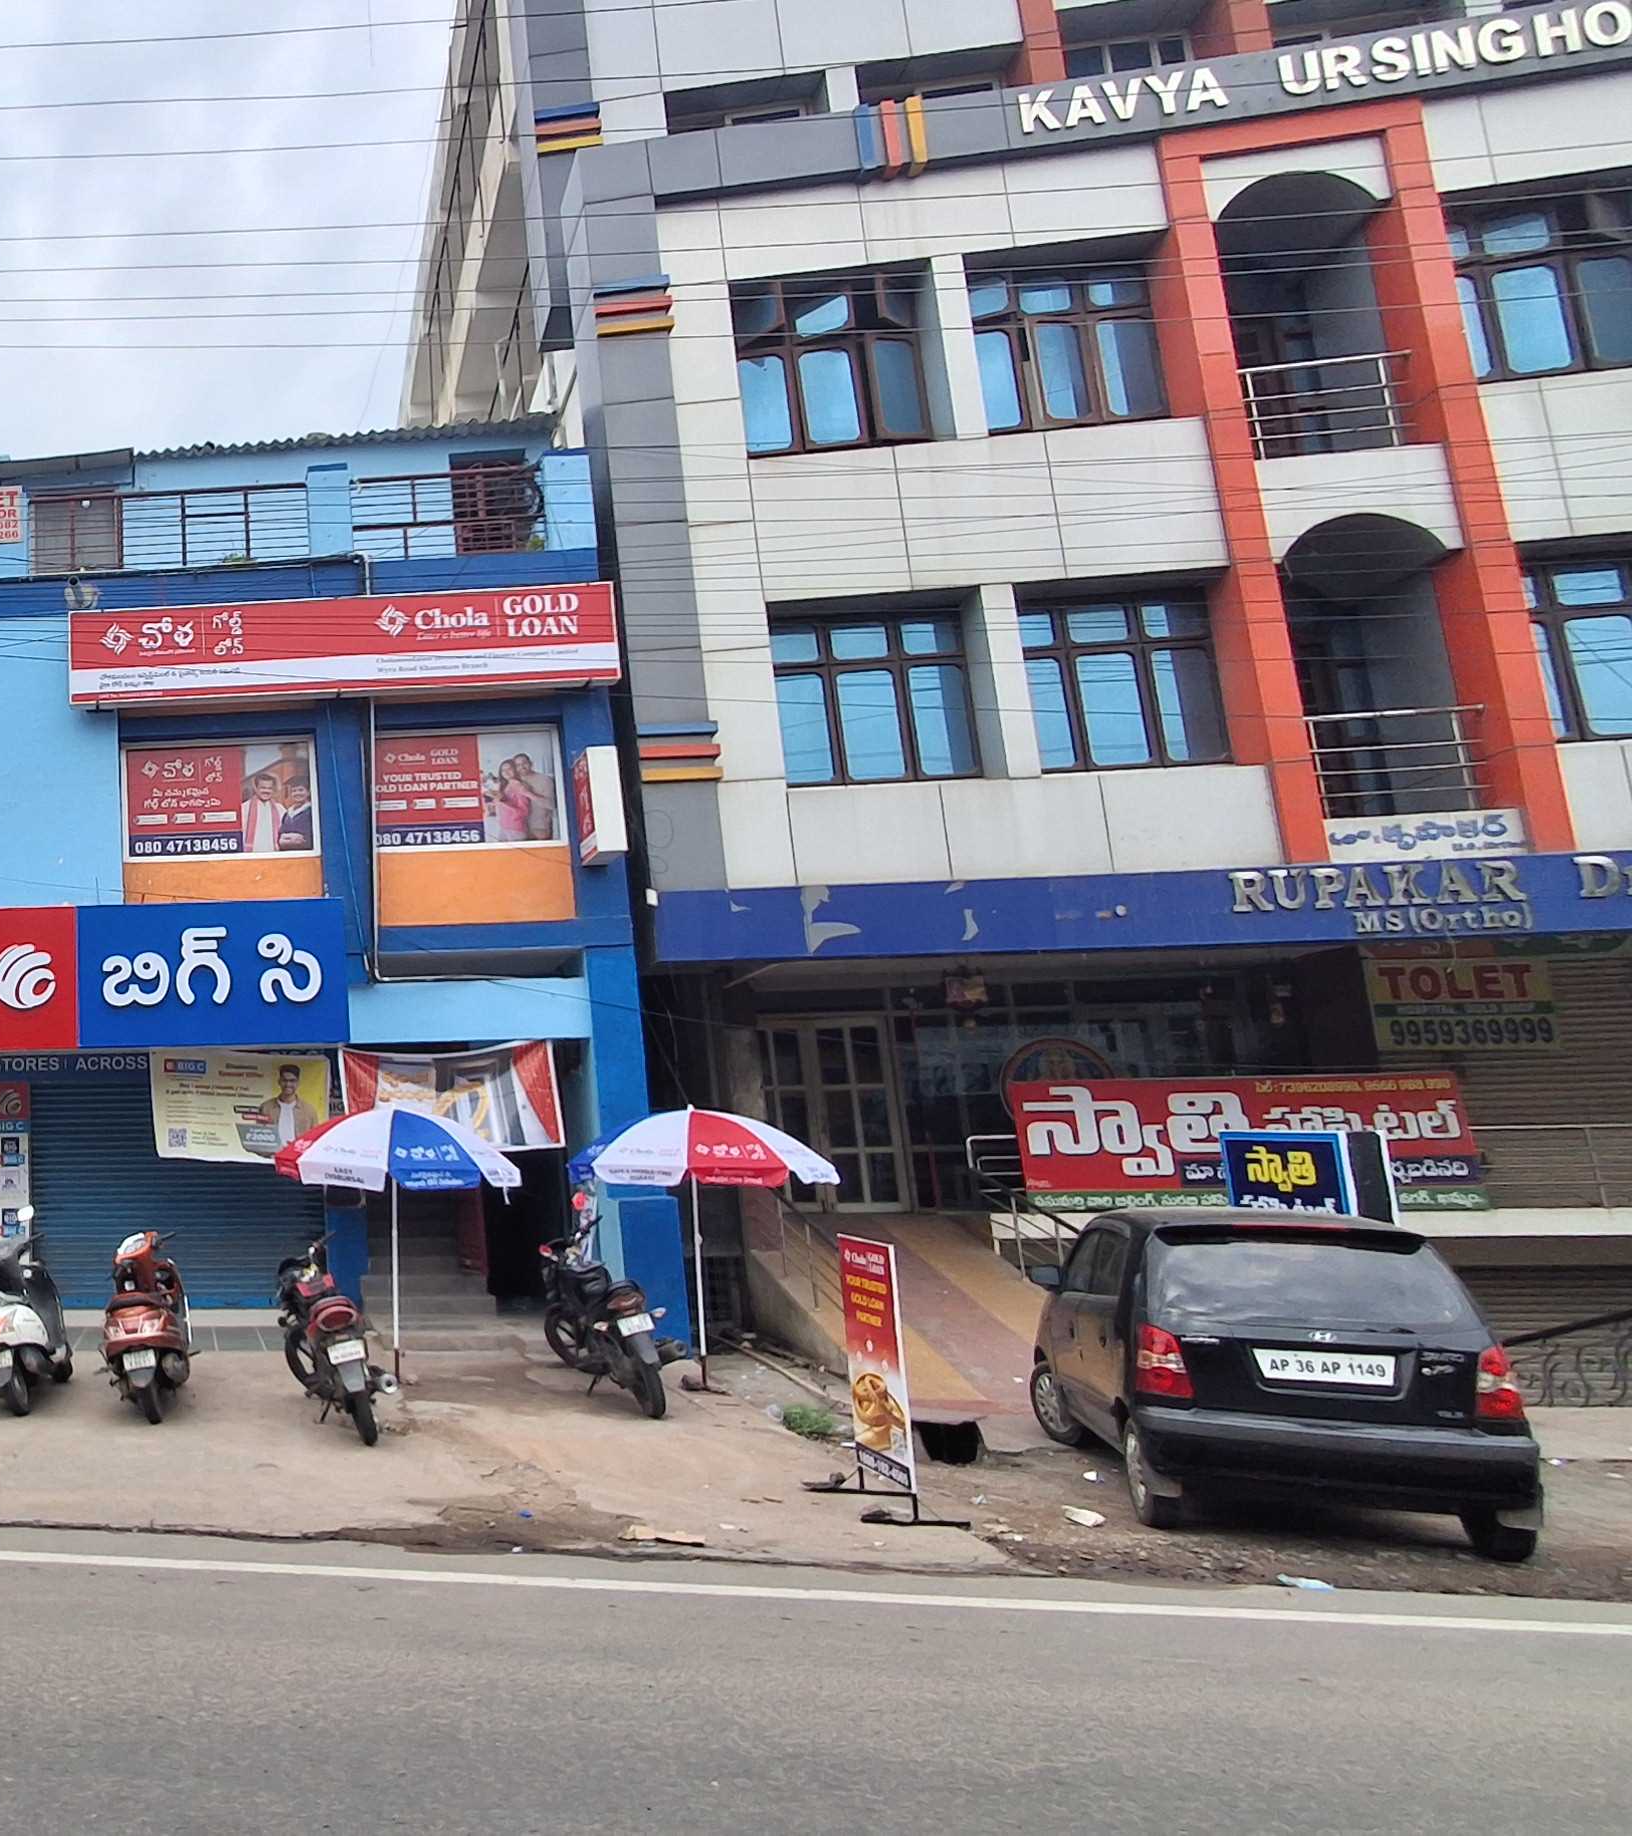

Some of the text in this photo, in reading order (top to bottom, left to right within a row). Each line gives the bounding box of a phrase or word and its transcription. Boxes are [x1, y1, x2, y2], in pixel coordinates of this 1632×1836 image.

[1019, 66, 1230, 134] KAVYA
[1279, 19, 1528, 95] URSING
[414, 593, 579, 630] Chola GOLD
[505, 615, 579, 637] LOAN
[213, 637, 244, 655] లోన్
[374, 780, 478, 794] OLD LOAN PARTNER
[383, 770, 462, 783] YOUR TRUSTED
[134, 838, 238, 855] 080 47138456
[405, 830, 480, 844] 47138456
[1229, 861, 1527, 913] RUPAKAR
[101, 926, 322, 1009] బిగ్ సి
[1378, 963, 1531, 1000] TOLET
[75, 1055, 148, 1071] ACROSS
[15, 1121, 24, 1131] C
[1023, 1086, 1249, 1177] స్వాతి
[1245, 1145, 1317, 1193] స్వాతి
[1269, 1358, 1386, 1378] AP 36 AP 1149
